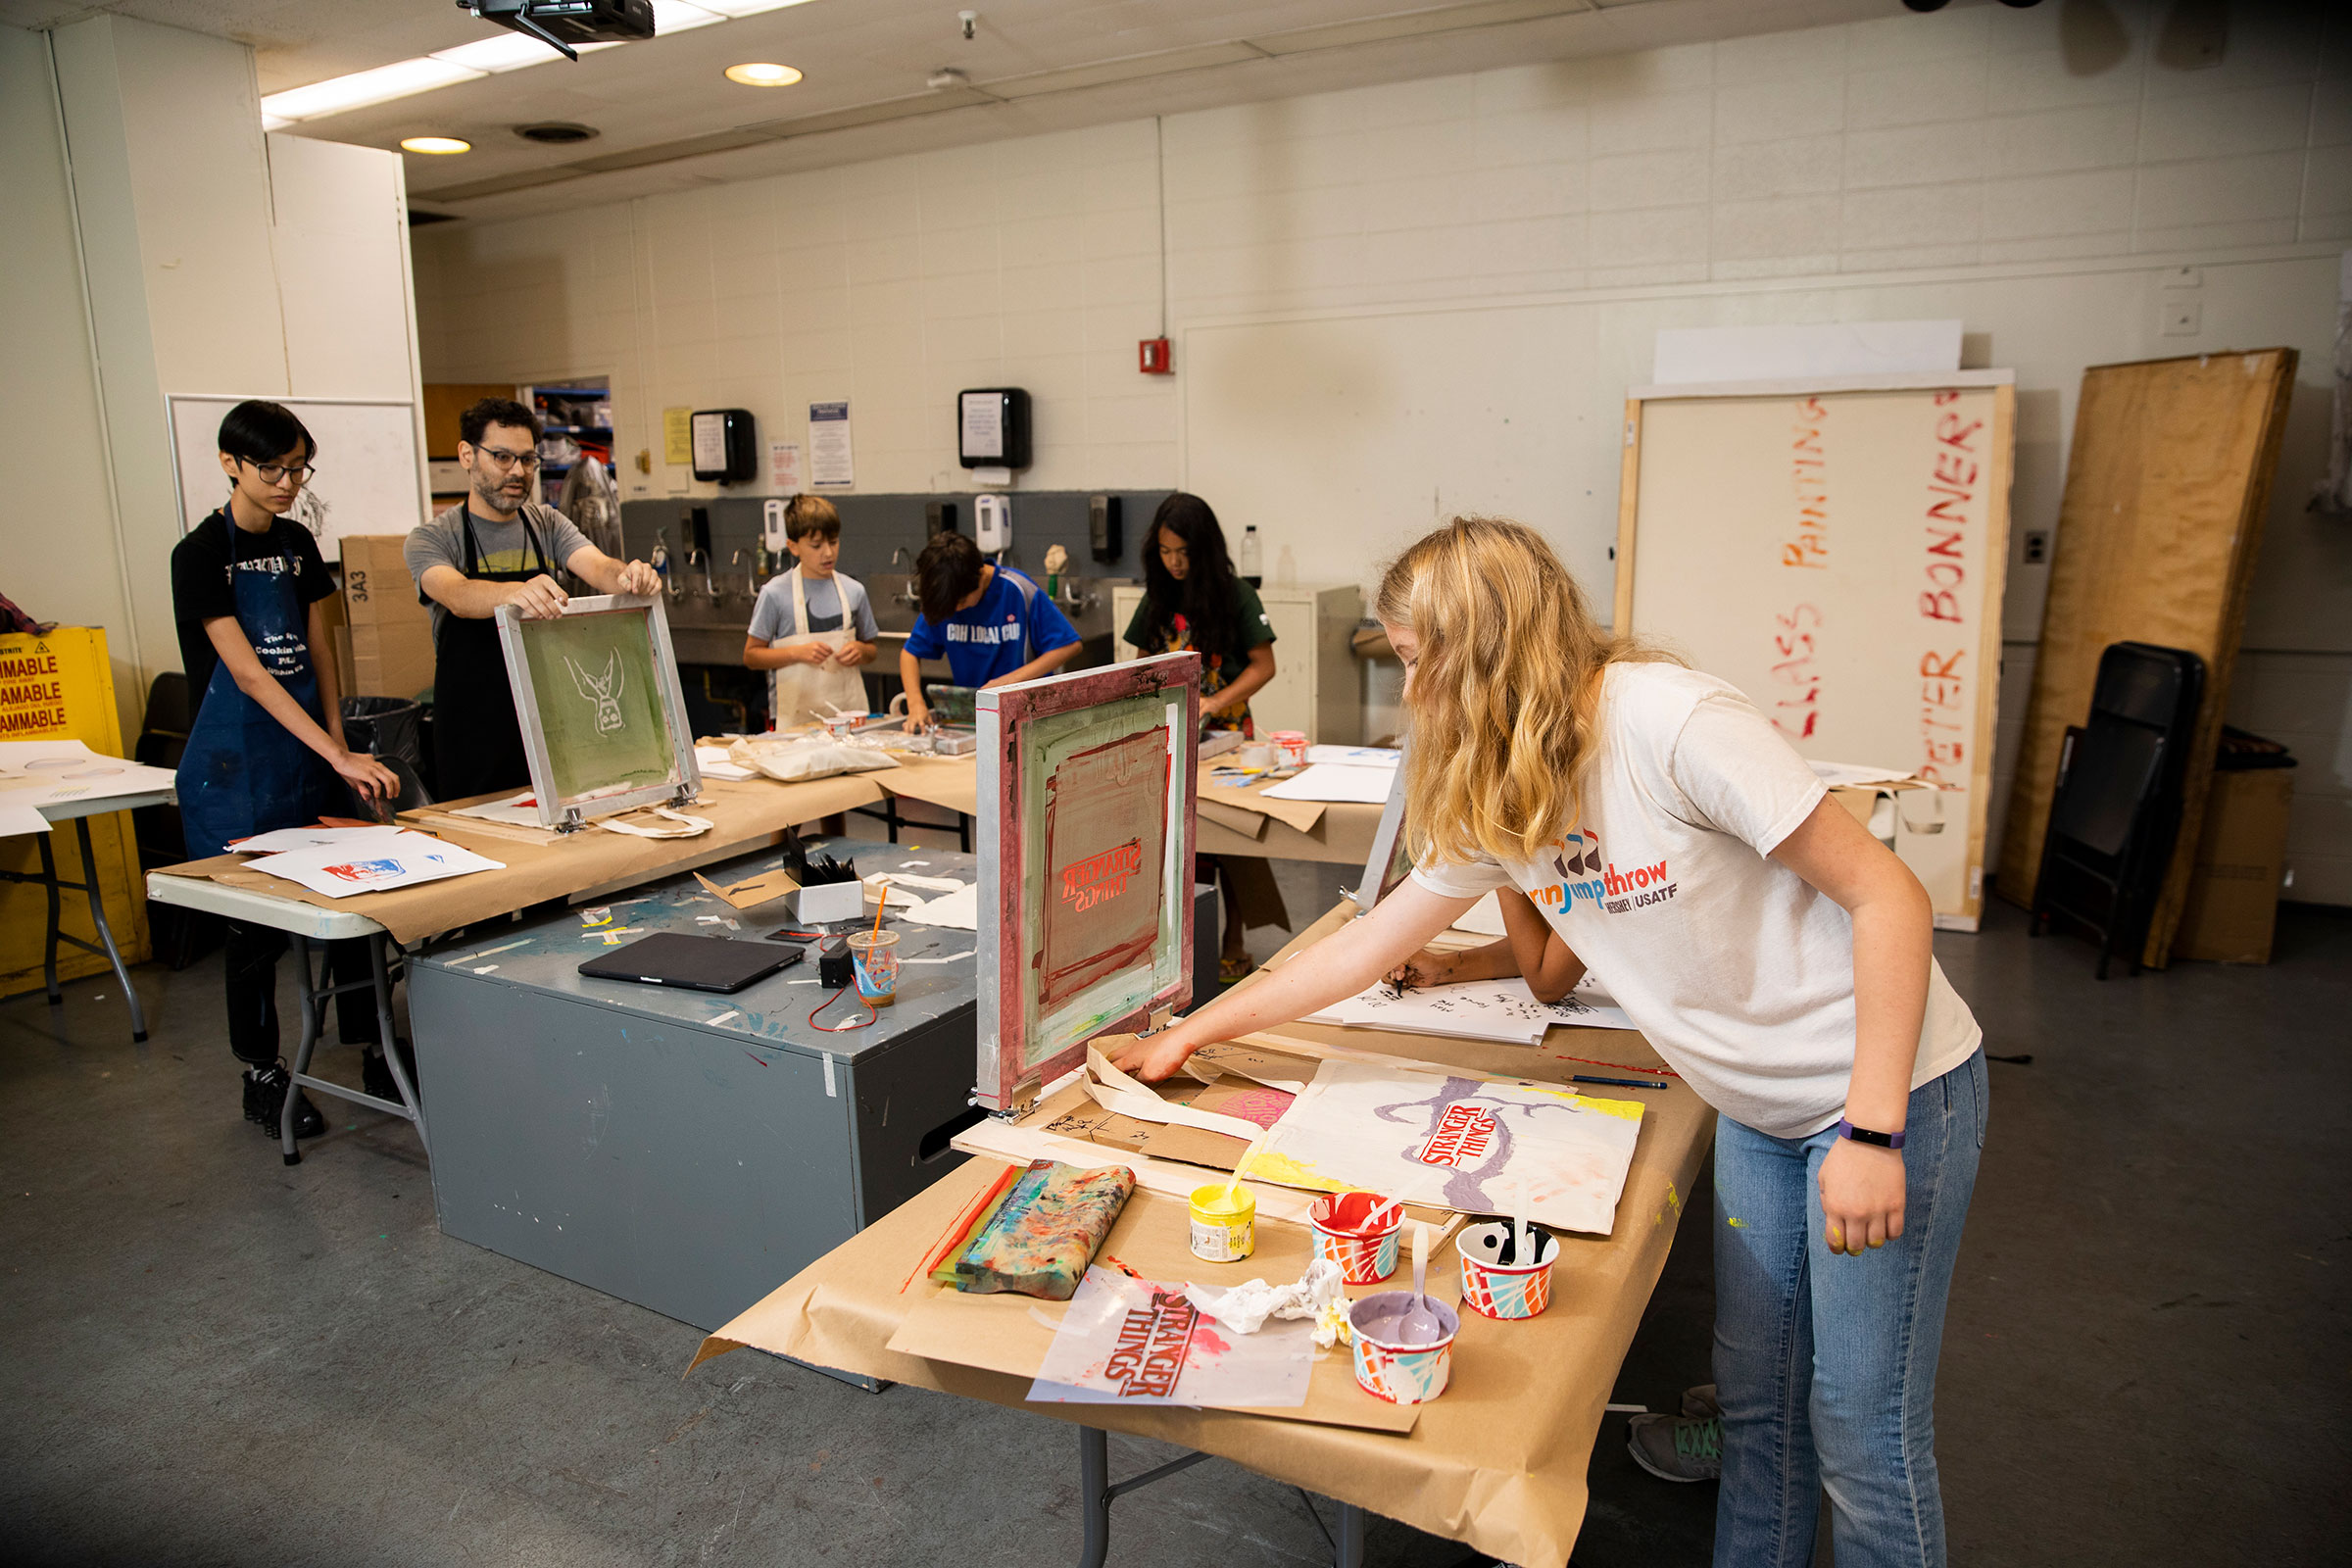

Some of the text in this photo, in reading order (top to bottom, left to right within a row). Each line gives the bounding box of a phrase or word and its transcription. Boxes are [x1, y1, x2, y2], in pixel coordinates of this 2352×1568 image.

[1781, 395, 1829, 570] PAINTING
[971, 625, 1001, 644] LOCAL
[0, 656, 59, 679] MABLE
[1919, 648, 1966, 792] PETER
[1635, 883, 1679, 908] USATF
[1422, 1104, 1482, 1166] STRANGER
[1456, 1117, 1496, 1157] THINGS
[1104, 1308, 1160, 1381] THINGS
[1125, 1293, 1196, 1396] STRANGER
